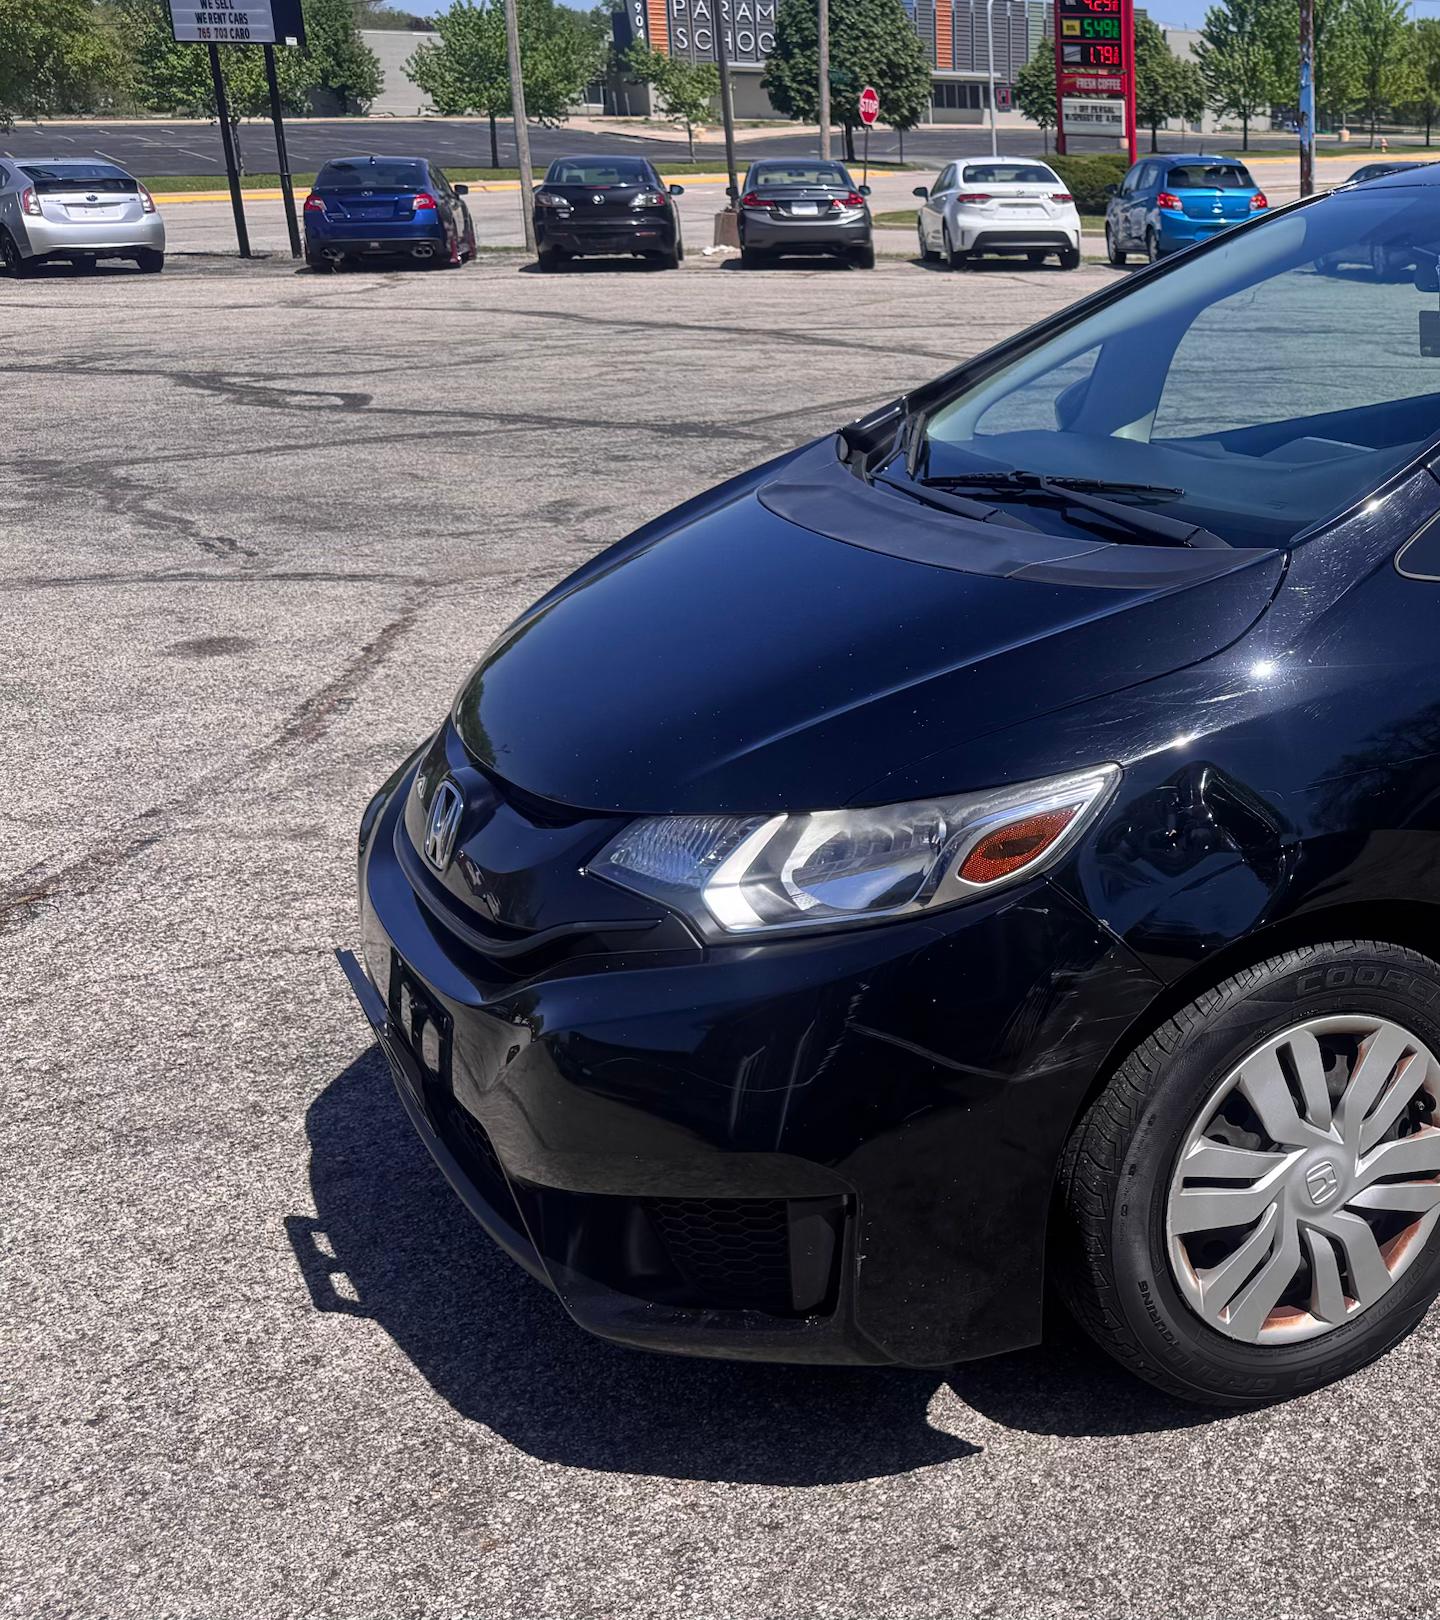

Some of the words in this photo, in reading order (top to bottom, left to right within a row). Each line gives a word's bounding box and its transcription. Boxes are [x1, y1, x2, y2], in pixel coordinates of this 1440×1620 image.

[200, 0, 213, 9] WE
[215, 0, 235, 9] SELL
[195, 12, 208, 24] WE
[208, 12, 226, 25] RENT
[229, 13, 249, 25] CARS
[197, 27, 211, 39] 765
[214, 28, 228, 39] 703
[229, 28, 250, 39] CARO
[1076, 78, 1097, 89] FRESH
[1098, 78, 1122, 91] COFFEE
[860, 98, 878, 113] STOP
